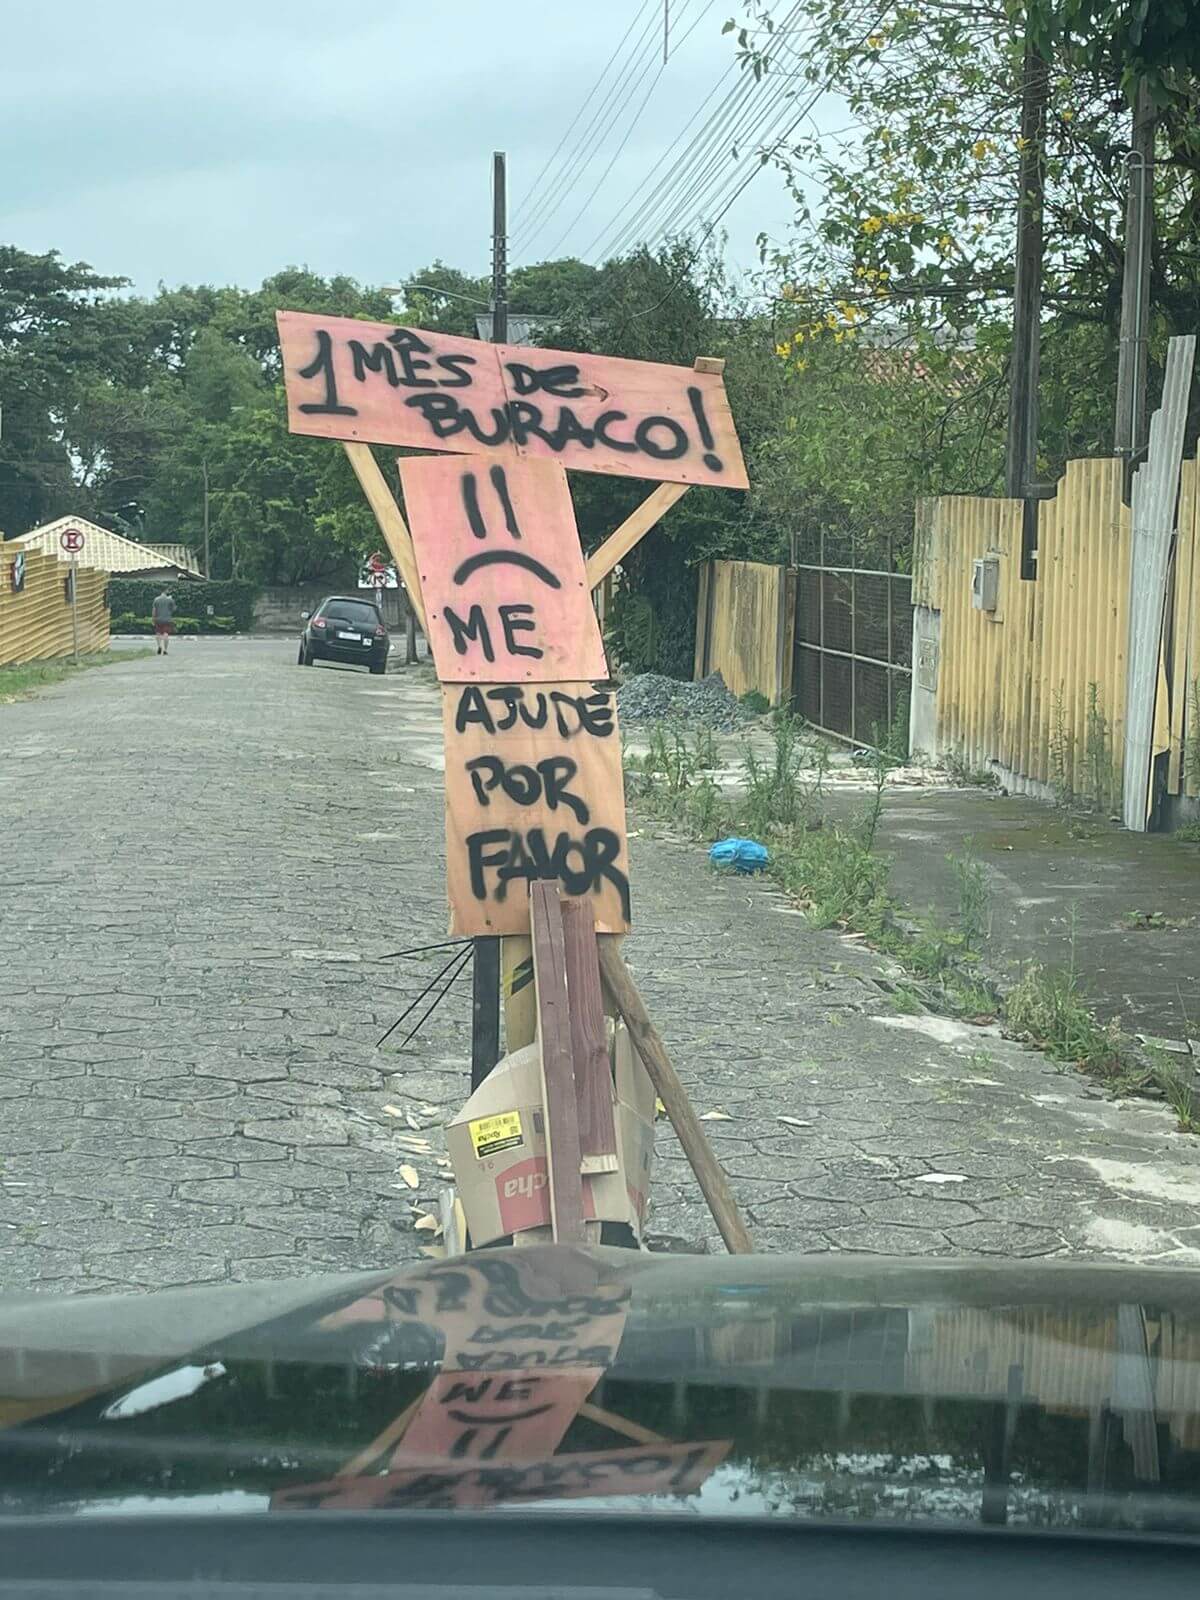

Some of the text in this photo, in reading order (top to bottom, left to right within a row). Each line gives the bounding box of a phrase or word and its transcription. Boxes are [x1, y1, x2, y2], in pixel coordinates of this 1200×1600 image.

[299, 328, 586, 417] 1 MÊS DE
[406, 387, 723, 472] BURACO!
[443, 604, 543, 662] ME
[455, 685, 615, 738] AJUDE
[464, 754, 590, 826] POR
[465, 827, 631, 923] FAVOR
